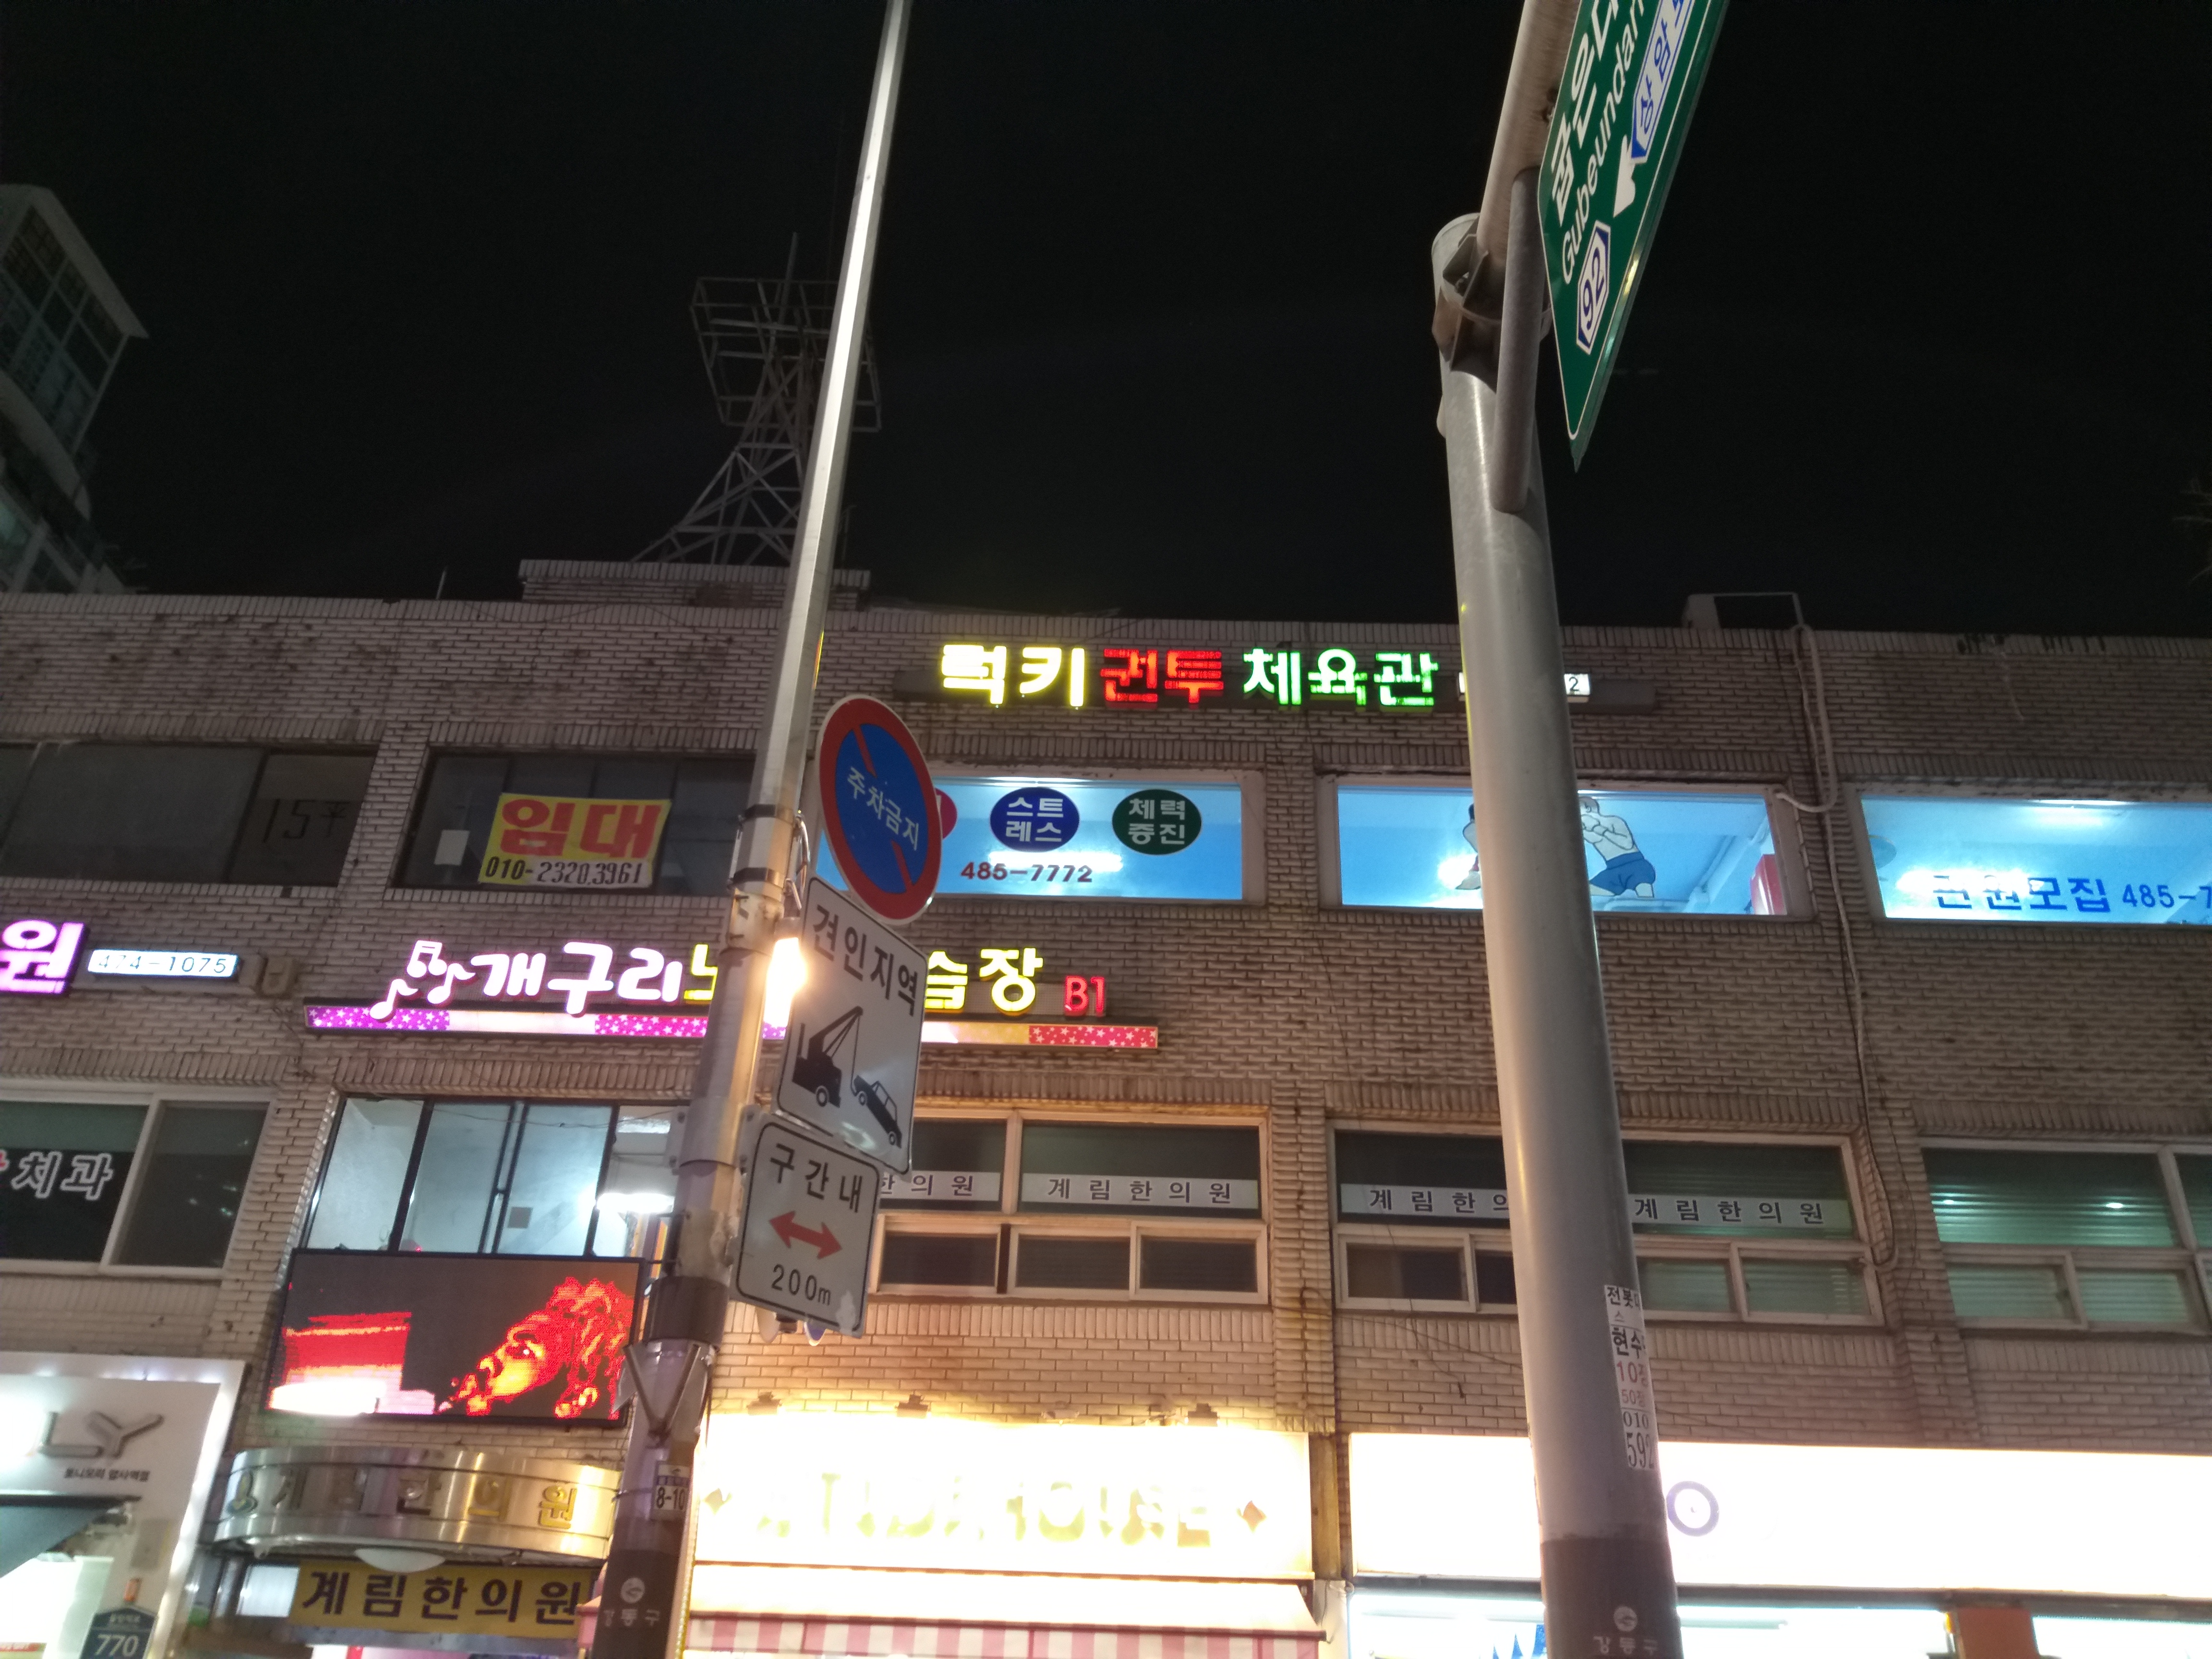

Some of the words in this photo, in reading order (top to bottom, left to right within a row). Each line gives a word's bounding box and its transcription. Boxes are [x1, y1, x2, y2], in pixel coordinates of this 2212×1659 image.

[1581, 250, 1605, 329] 92
[941, 644, 1085, 707] 럭키
[1101, 649, 1224, 704] 권투
[1242, 648, 1438, 706] 체육관
[847, 766, 919, 851] 주차금지
[1006, 797, 1064, 817] 스트
[1129, 798, 1186, 820] 체력
[500, 799, 662, 858] 임대
[1006, 821, 1062, 842] 레스
[1128, 823, 1185, 845] 증진
[961, 861, 1093, 883] 485-7772
[99, 955, 226, 974] 474-1075
[811, 903, 919, 1017] 견인지역
[470, 941, 682, 1015] 개구리
[1065, 976, 1105, 1016] B1
[769, 1142, 863, 1214] 구간내
[1047, 1178, 1232, 1204] 계림한의원
[1634, 1198, 1825, 1224] 계림한의원
[770, 1263, 831, 1306] 200m
[1611, 1327, 1646, 1359] 현수
[303, 1571, 581, 1626] 계림한의원
[94, 1634, 139, 1657] 770
